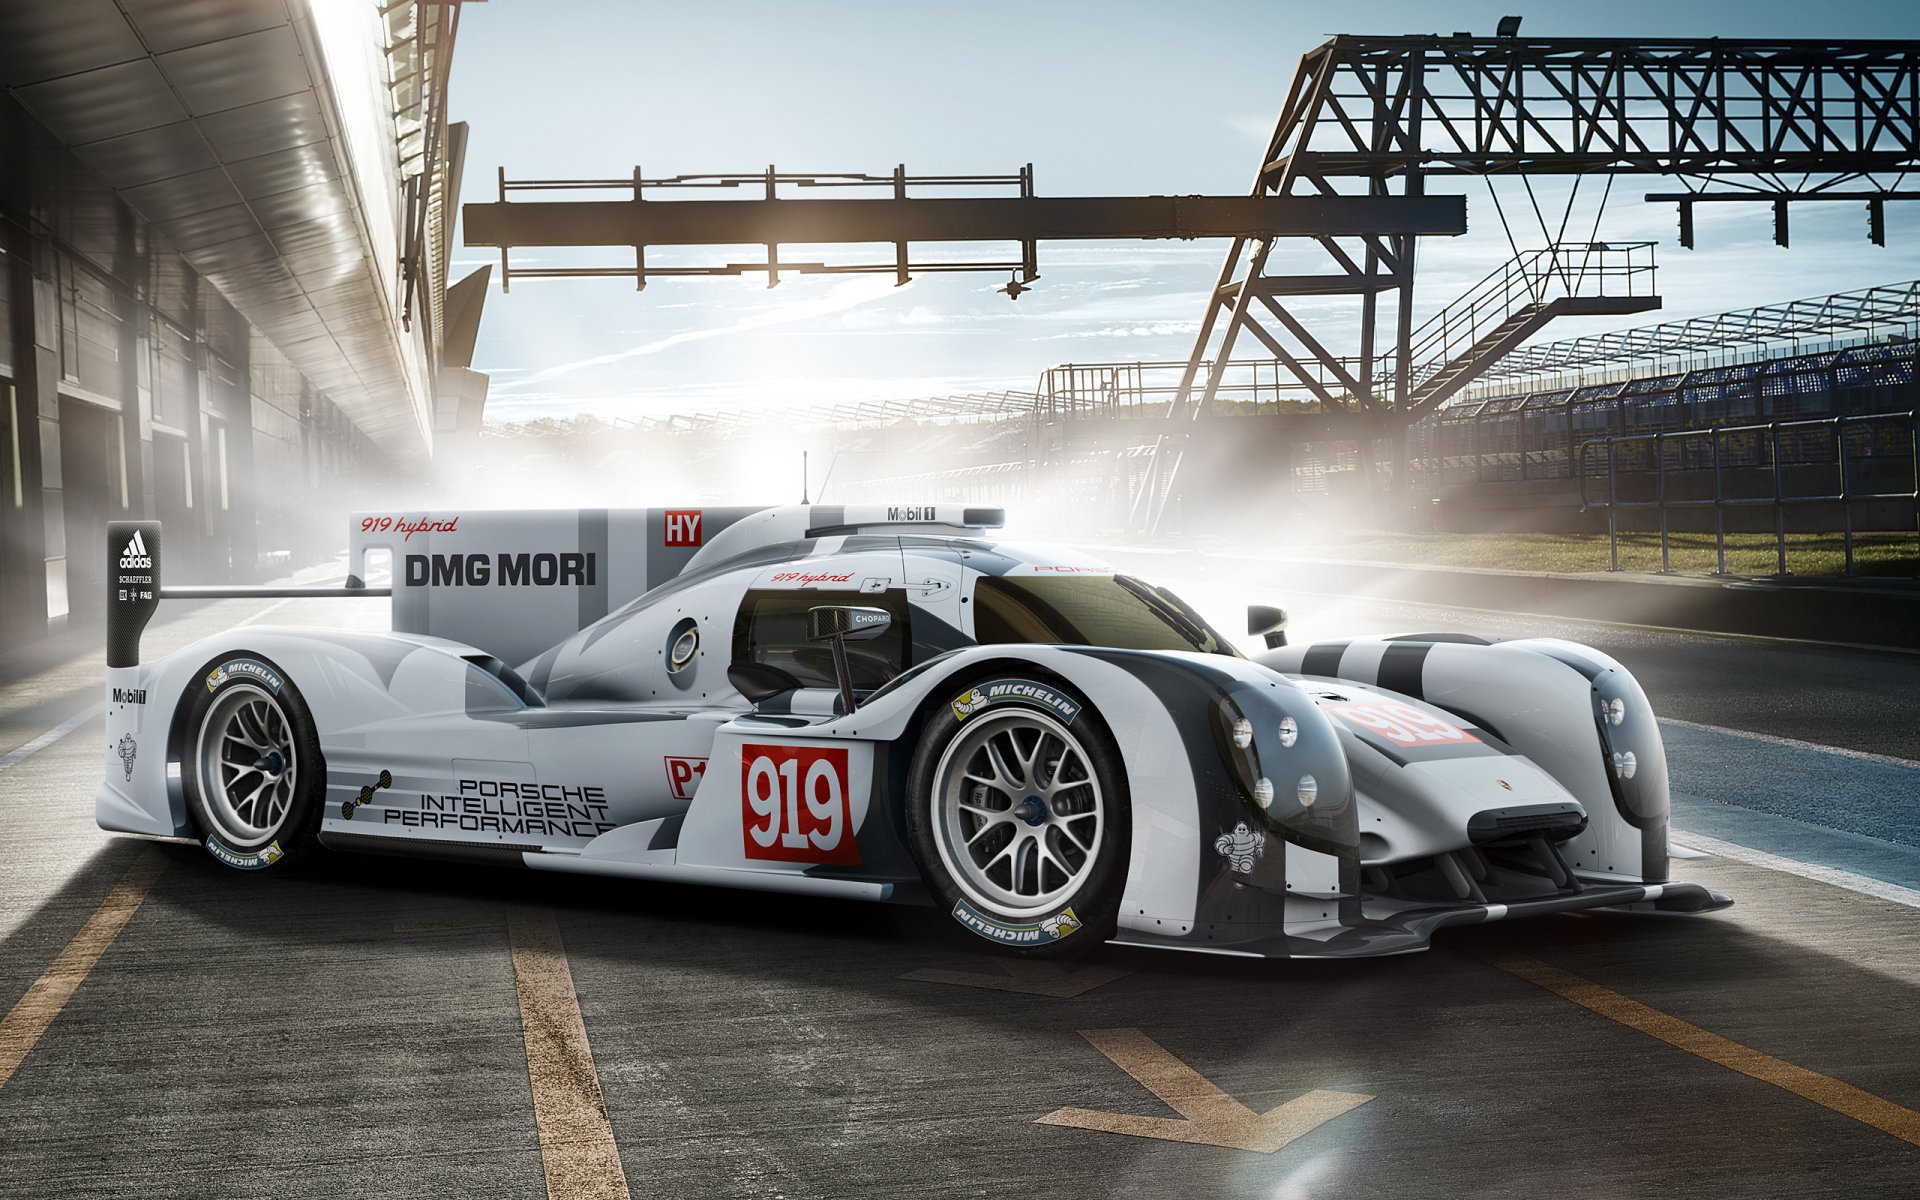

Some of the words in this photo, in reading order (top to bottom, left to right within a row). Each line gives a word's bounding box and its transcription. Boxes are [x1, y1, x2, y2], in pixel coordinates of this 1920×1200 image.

[888, 507, 921, 521] Mobil
[361, 517, 393, 532] 919
[393, 516, 459, 542] hybrid
[667, 514, 700, 542] HY
[120, 555, 152, 569] adidas
[406, 554, 490, 587] DMG
[498, 553, 596, 586] MORI
[119, 575, 152, 583] SCHAEFFLER
[771, 572, 800, 582] 919
[797, 572, 854, 587] hybrid
[140, 591, 152, 600] FAG
[228, 663, 280, 688] MICHELIN
[113, 688, 138, 703] Mobil
[989, 684, 1075, 715] MICHELIN
[1334, 704, 1463, 742] 919
[460, 780, 607, 803] PORSCHE
[747, 755, 843, 851] 919
[421, 794, 609, 821] INTELLIGENT
[384, 809, 617, 838] PERFORMANCE
[208, 842, 258, 867] MICHELIN
[956, 908, 1040, 941] MICHELIN
